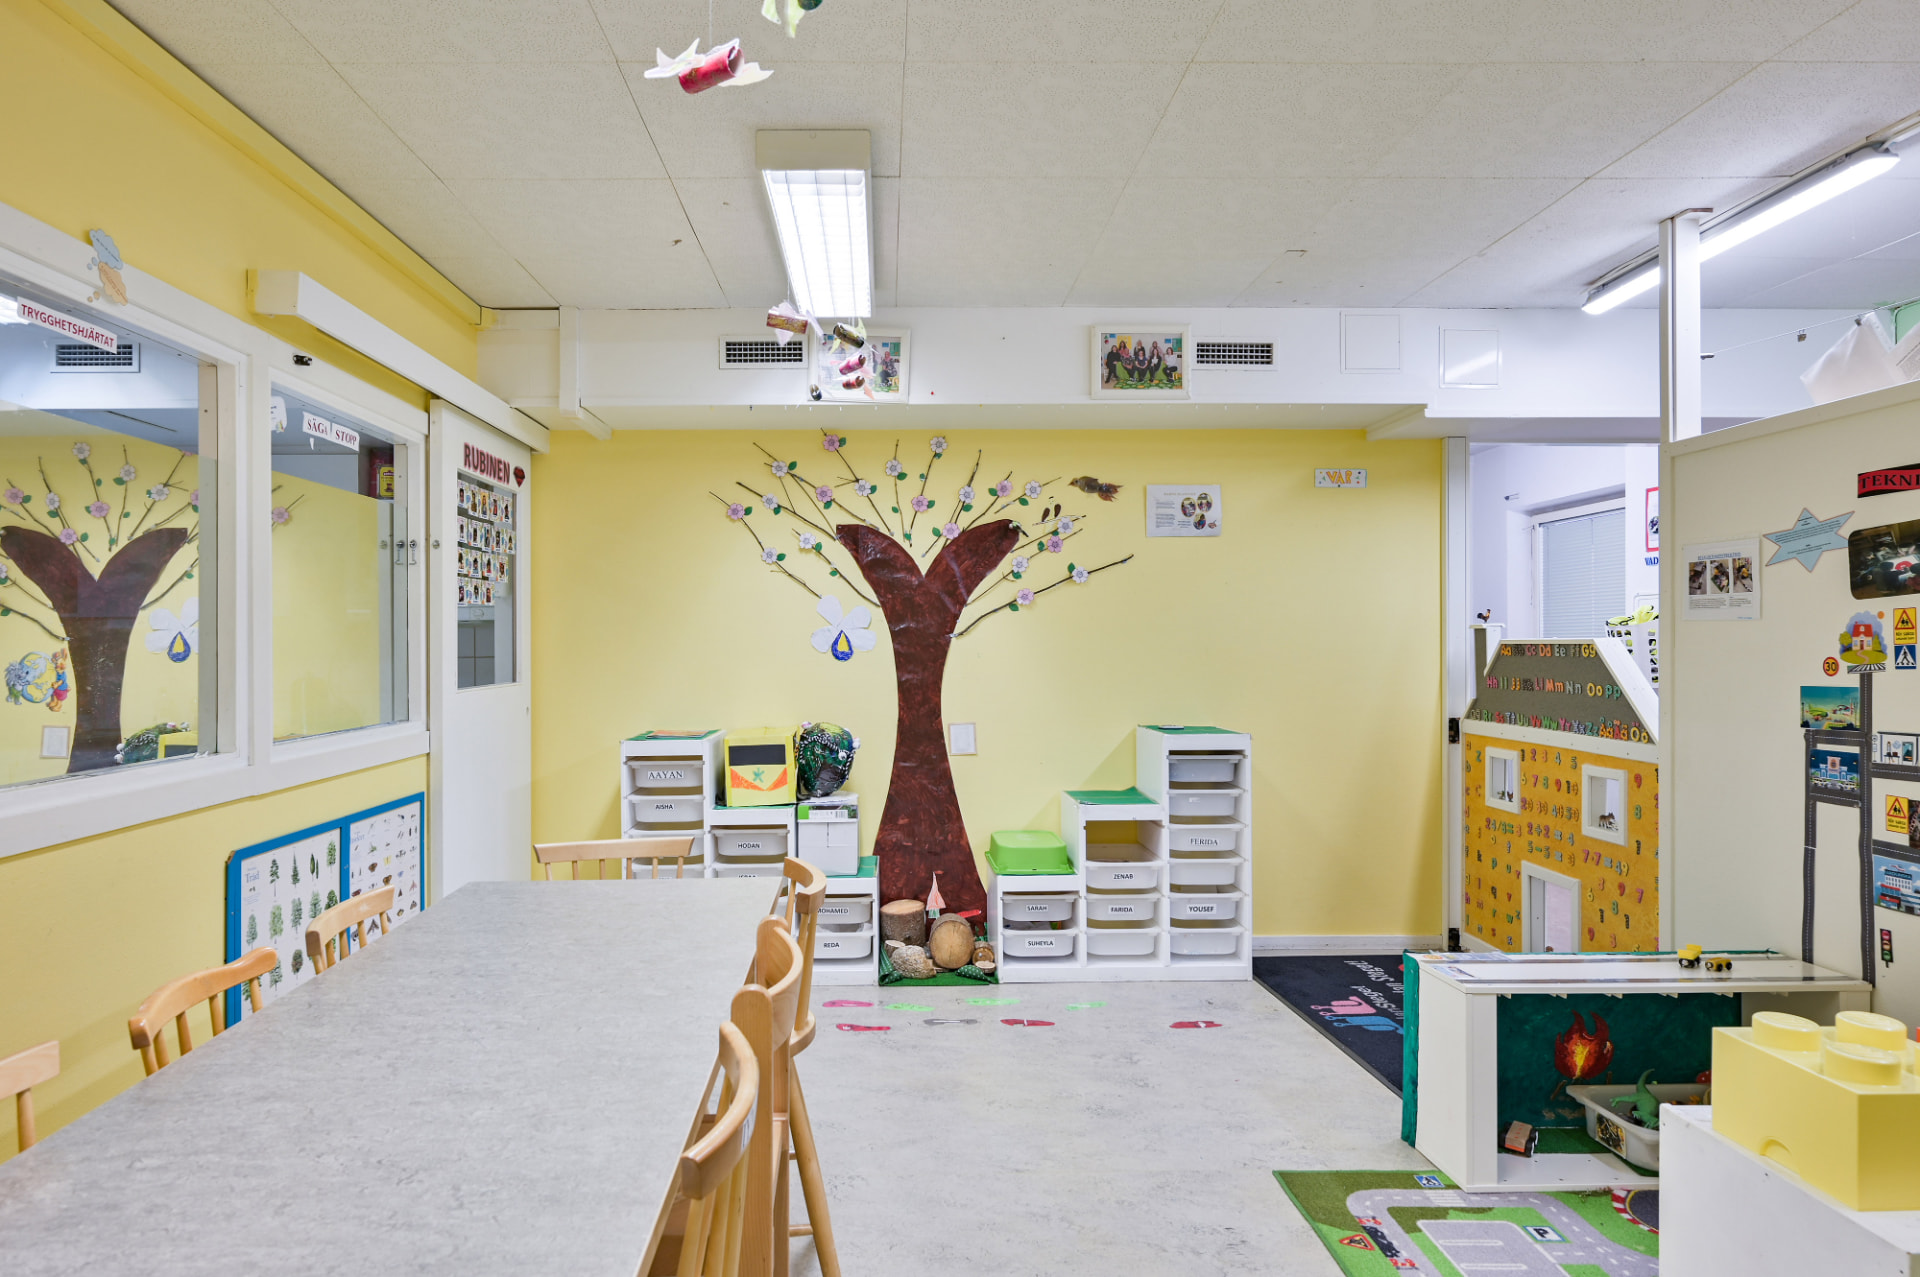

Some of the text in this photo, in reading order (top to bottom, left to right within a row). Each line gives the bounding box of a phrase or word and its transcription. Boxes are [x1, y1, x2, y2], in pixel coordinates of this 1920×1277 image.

[21, 303, 114, 348] TRYGGHETSHJÄRTAT
[335, 429, 357, 446] STOPP
[464, 442, 510, 485] RUBINEN
[1825, 661, 1837, 672] 30
[648, 770, 683, 780] AAYAN
[1190, 838, 1218, 846] FERIDA
[1533, 1227, 1549, 1239] P
